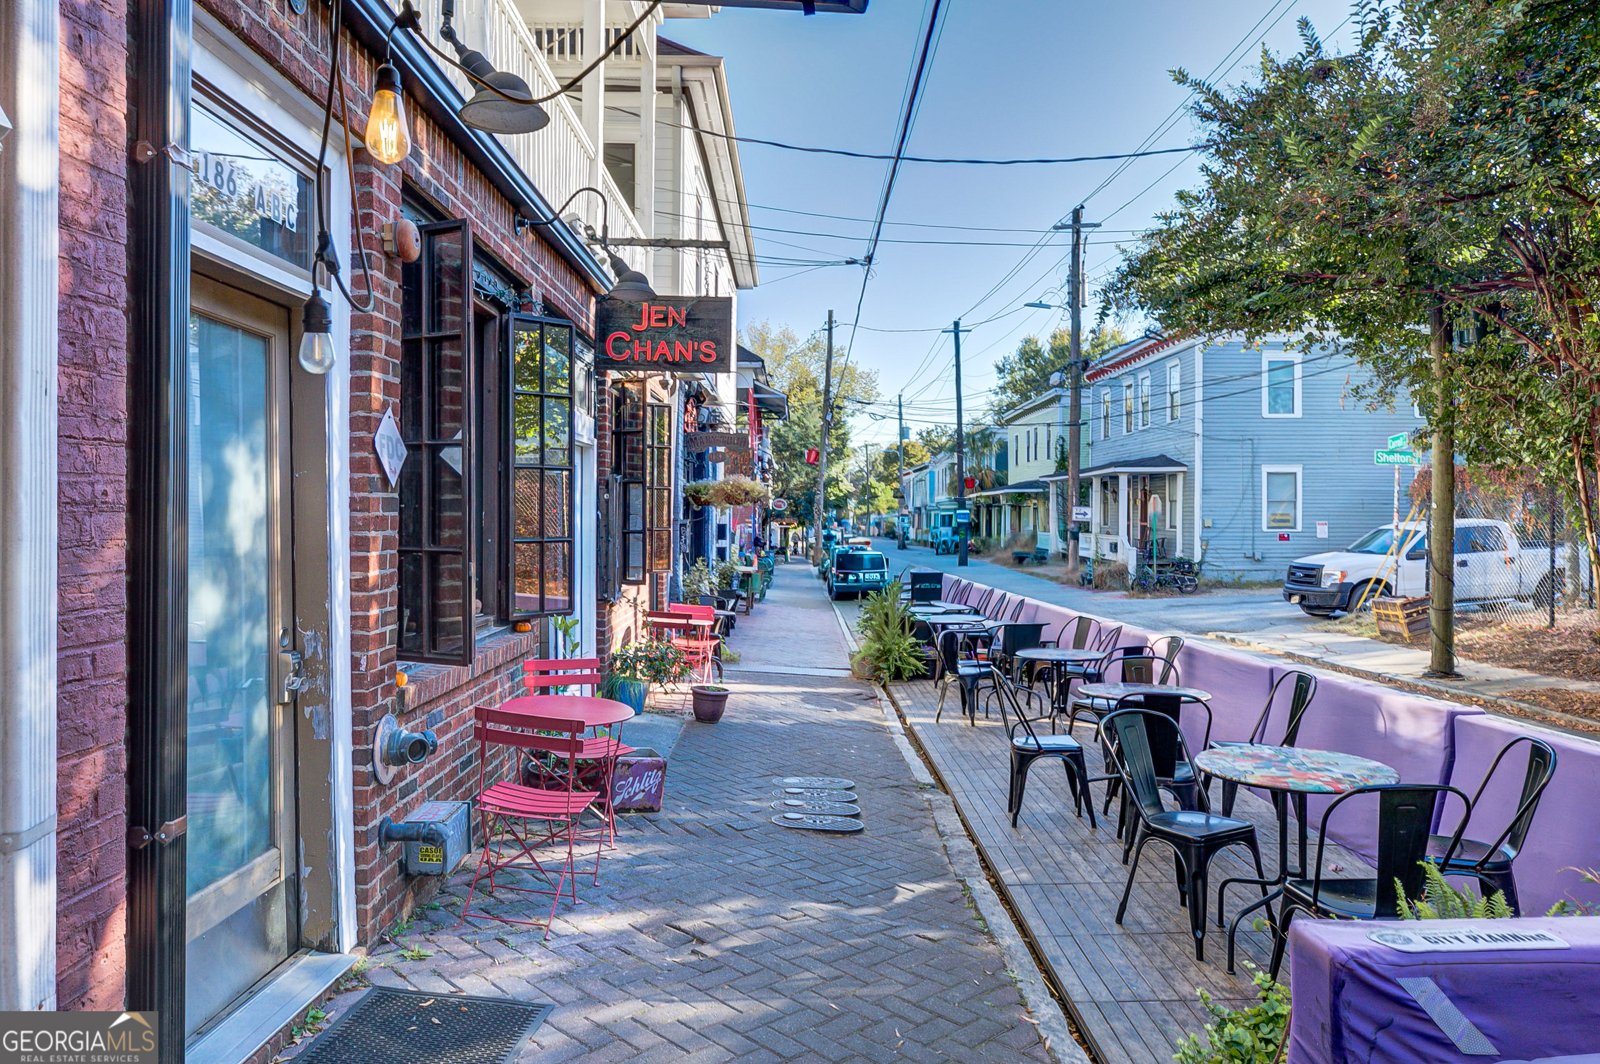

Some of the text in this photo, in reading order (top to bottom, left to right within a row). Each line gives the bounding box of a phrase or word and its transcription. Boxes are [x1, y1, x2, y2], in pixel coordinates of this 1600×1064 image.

[202, 153, 237, 197] 186
[631, 302, 687, 332] JEN
[605, 330, 717, 363] CHAN'S
[612, 769, 663, 807] Schlitz
[1422, 935, 1466, 945] CITY
